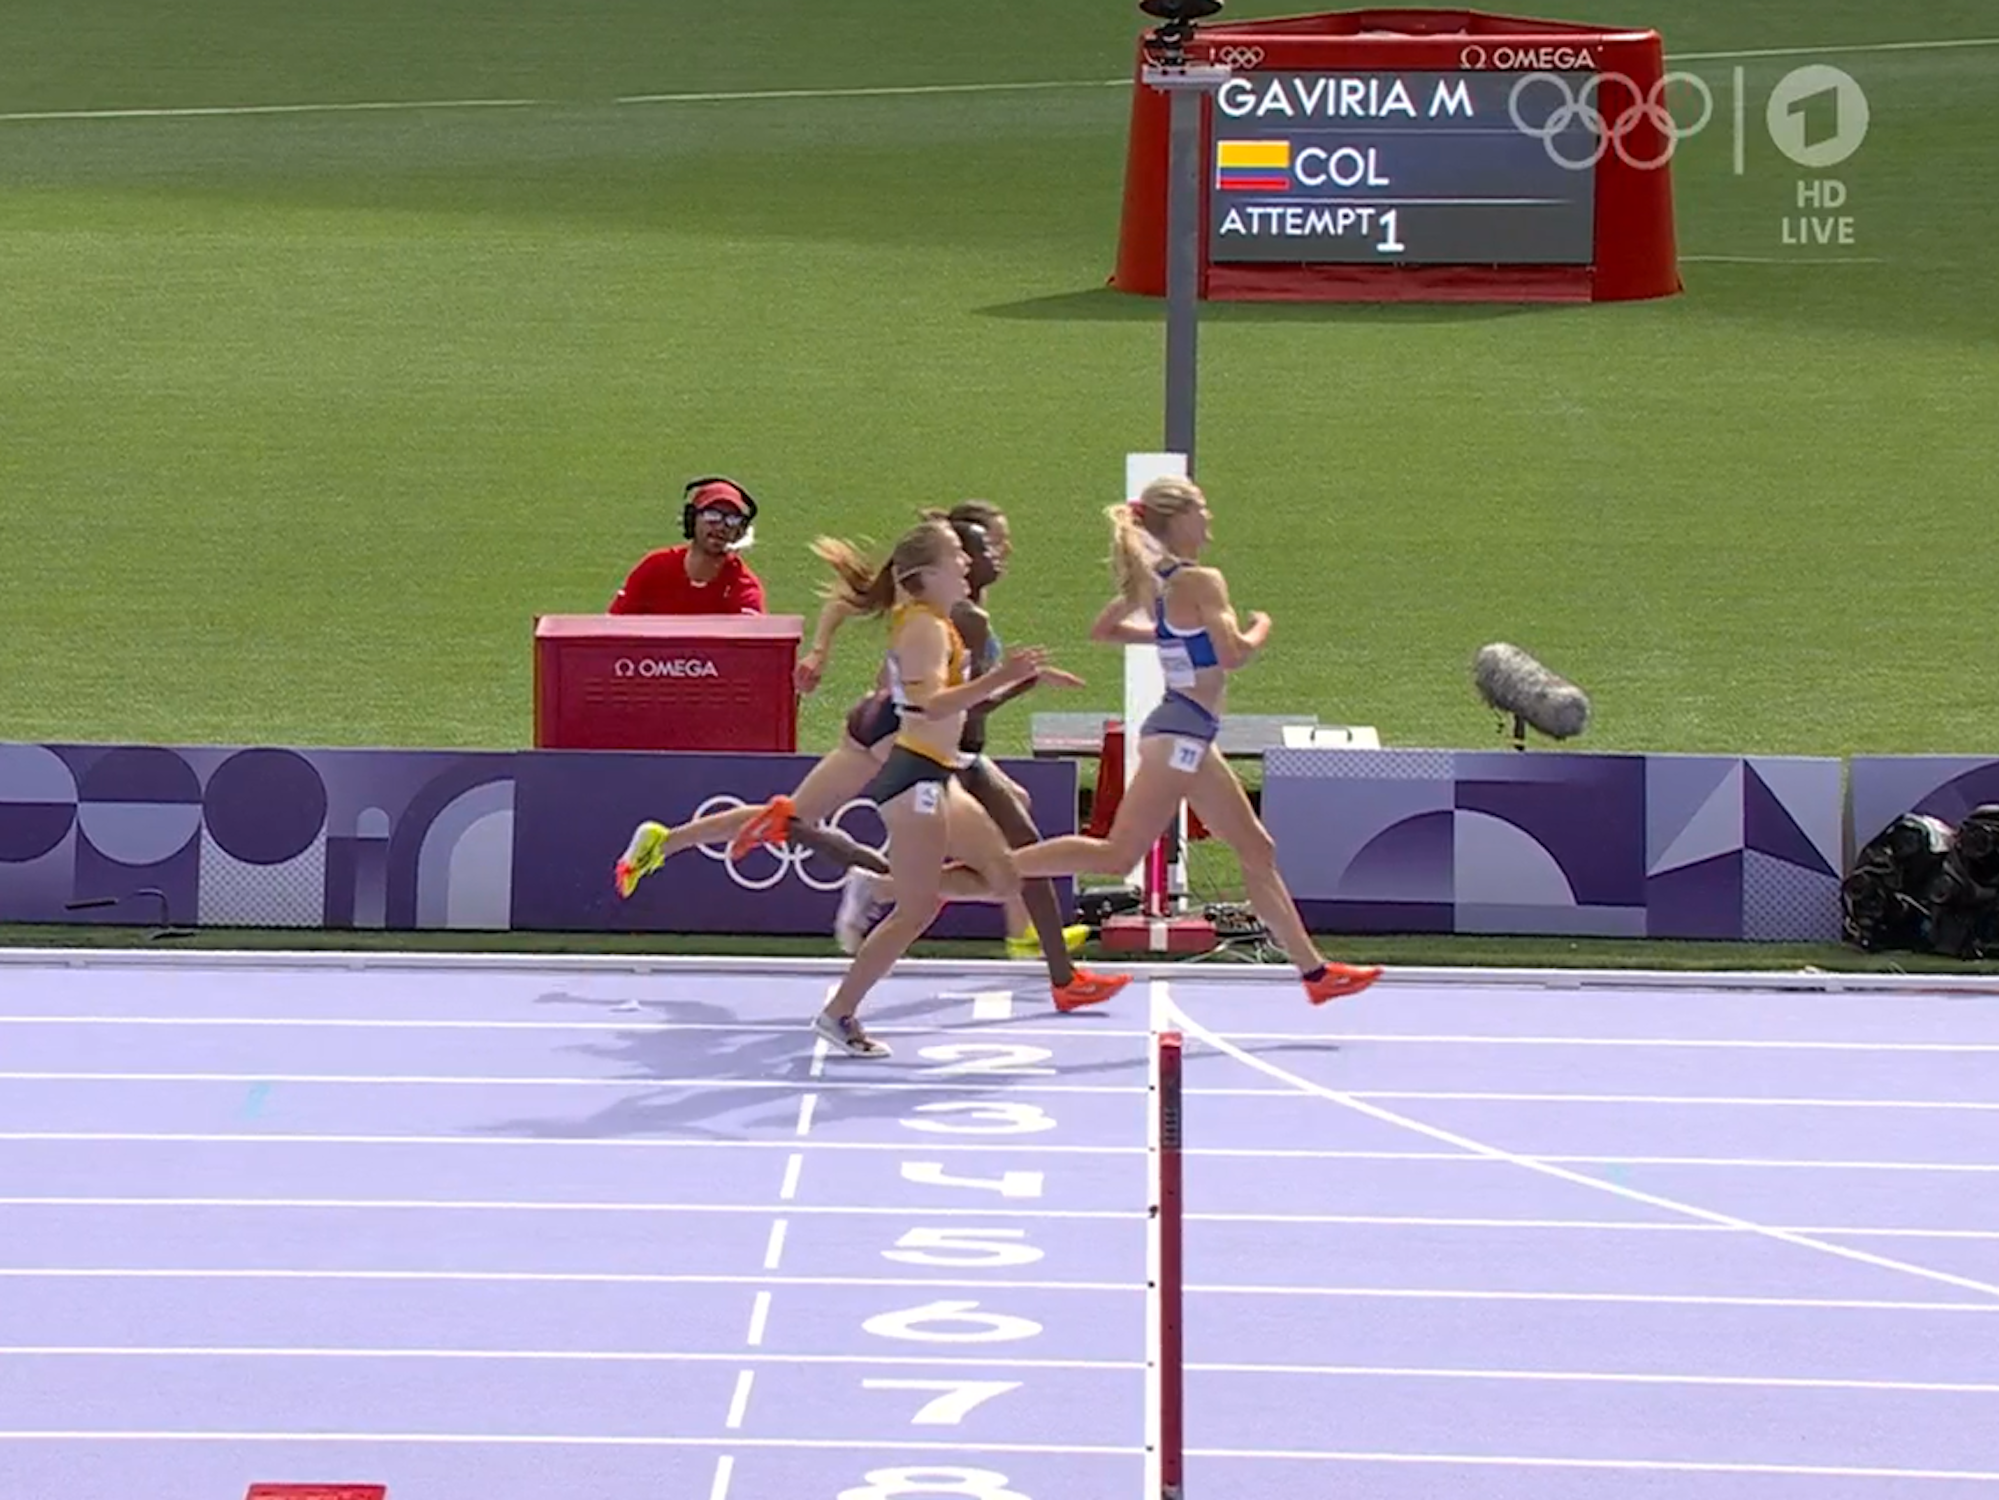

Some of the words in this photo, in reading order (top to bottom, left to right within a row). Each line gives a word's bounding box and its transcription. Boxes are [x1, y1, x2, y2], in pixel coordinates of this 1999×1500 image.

[1493, 47, 1596, 69] OMEGA
[1218, 78, 1417, 117] GAVIRIA
[1429, 78, 1474, 117] M
[1294, 146, 1390, 187] COL
[1219, 207, 1376, 235] ATTEMPT
[1376, 209, 1405, 252] 1
[638, 658, 718, 677] OMEGA
[937, 991, 1013, 1019] 1
[915, 1044, 1056, 1075] 2
[899, 1101, 1057, 1134] 3
[880, 1228, 1045, 1267] 5
[861, 1300, 1043, 1342] 6
[862, 1379, 1024, 1424] 7
